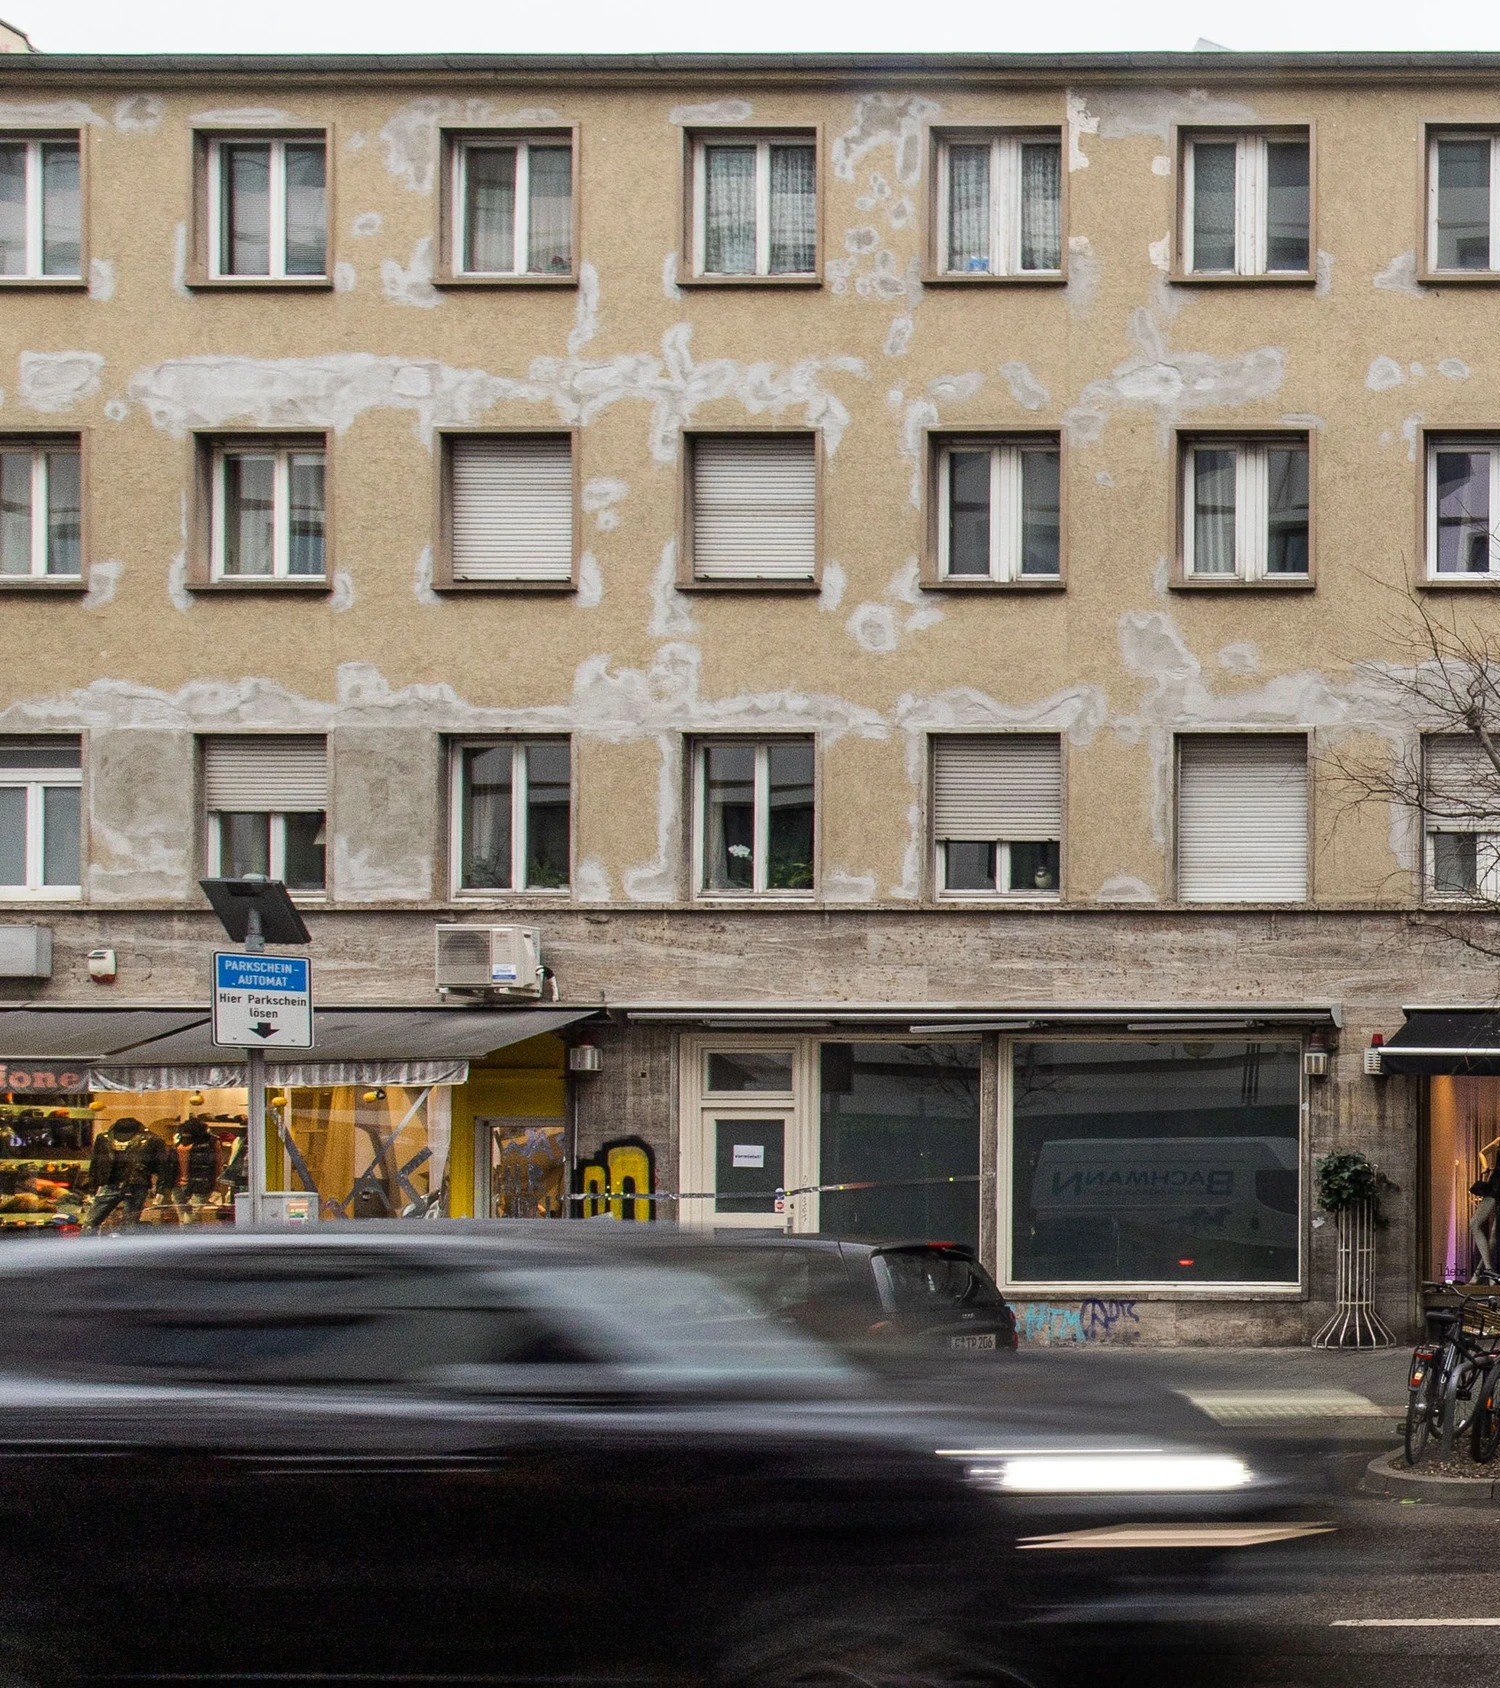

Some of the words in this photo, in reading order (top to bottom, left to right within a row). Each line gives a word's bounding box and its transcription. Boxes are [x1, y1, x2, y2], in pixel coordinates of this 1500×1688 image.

[224, 960, 300, 974] PARKSCHEIN-
[238, 974, 288, 987] AUTOMAT
[219, 993, 242, 1003] Hier
[248, 994, 307, 1007] Parkschein
[249, 1008, 278, 1018] lösen
